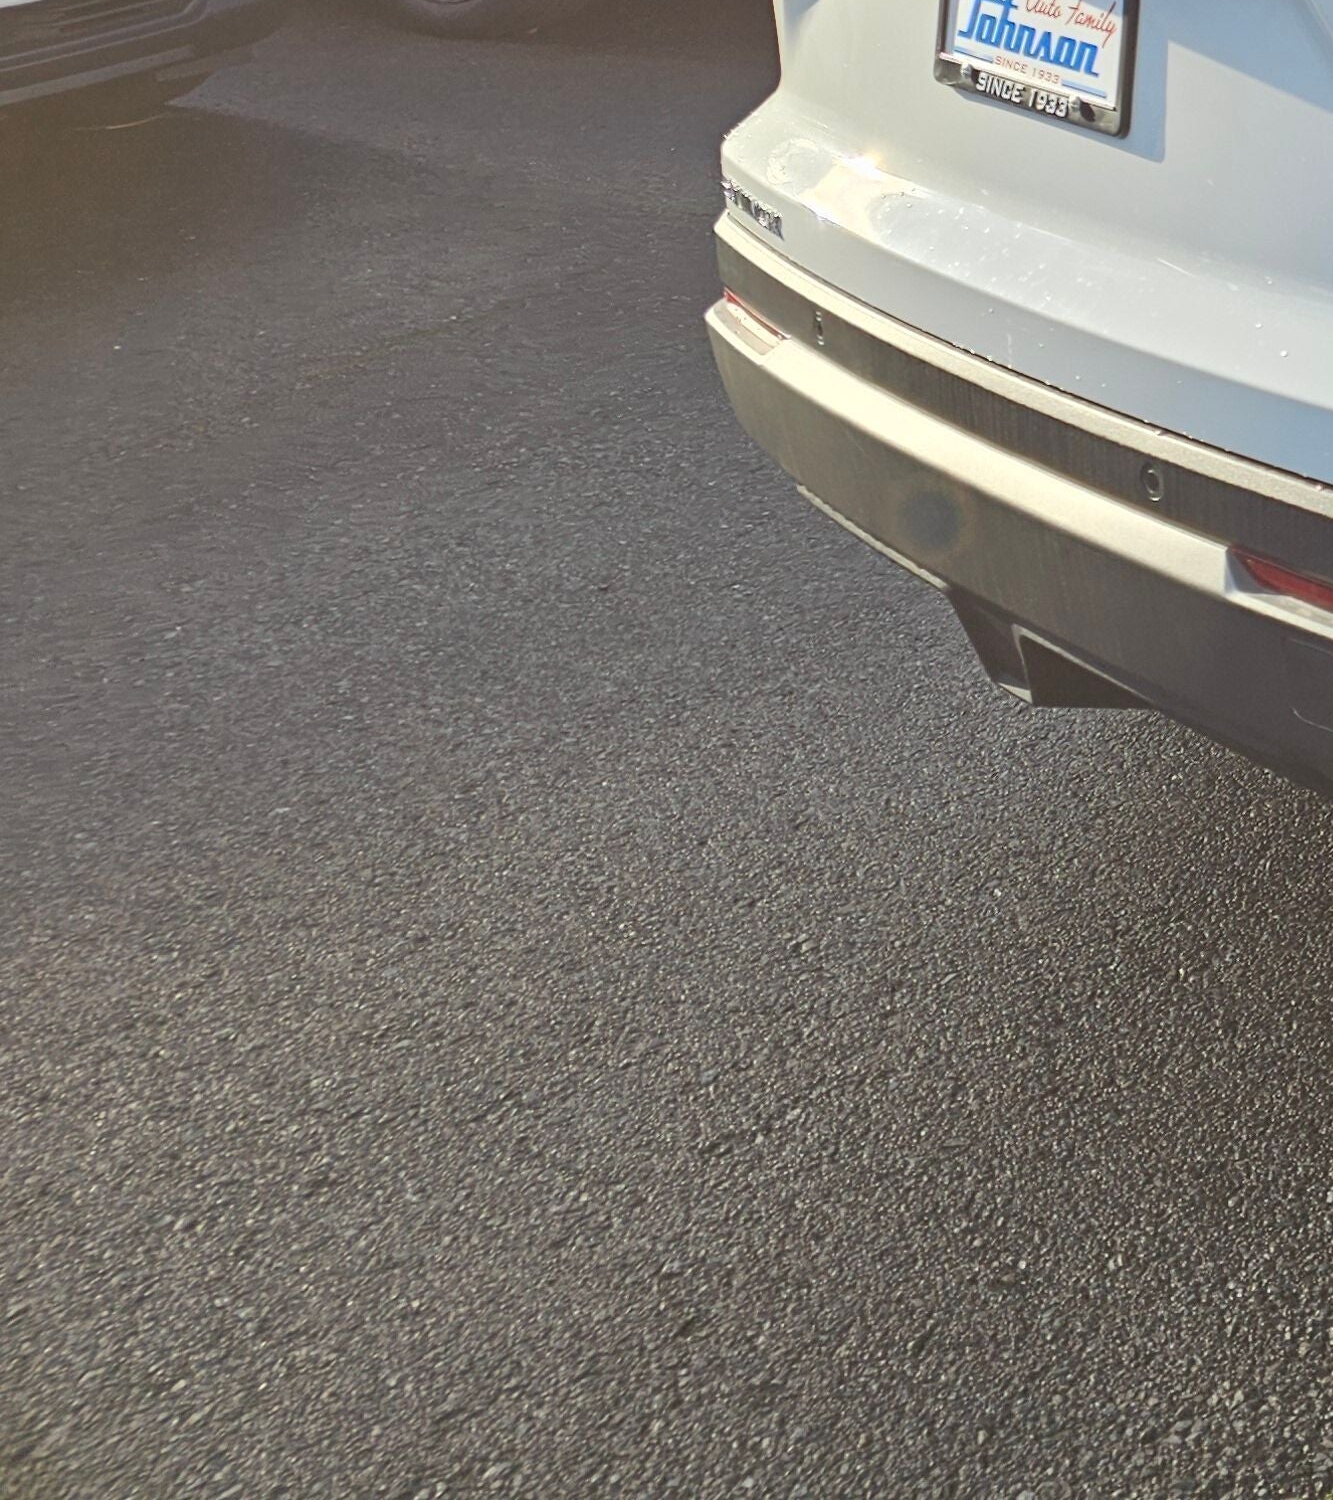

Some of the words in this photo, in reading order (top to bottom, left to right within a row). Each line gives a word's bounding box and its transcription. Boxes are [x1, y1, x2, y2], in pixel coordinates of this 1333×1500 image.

[995, 55, 1028, 75] SINCE
[1032, 67, 1061, 84] 1933
[976, 73, 1025, 104] SINCE
[1029, 89, 1069, 117] 1933
